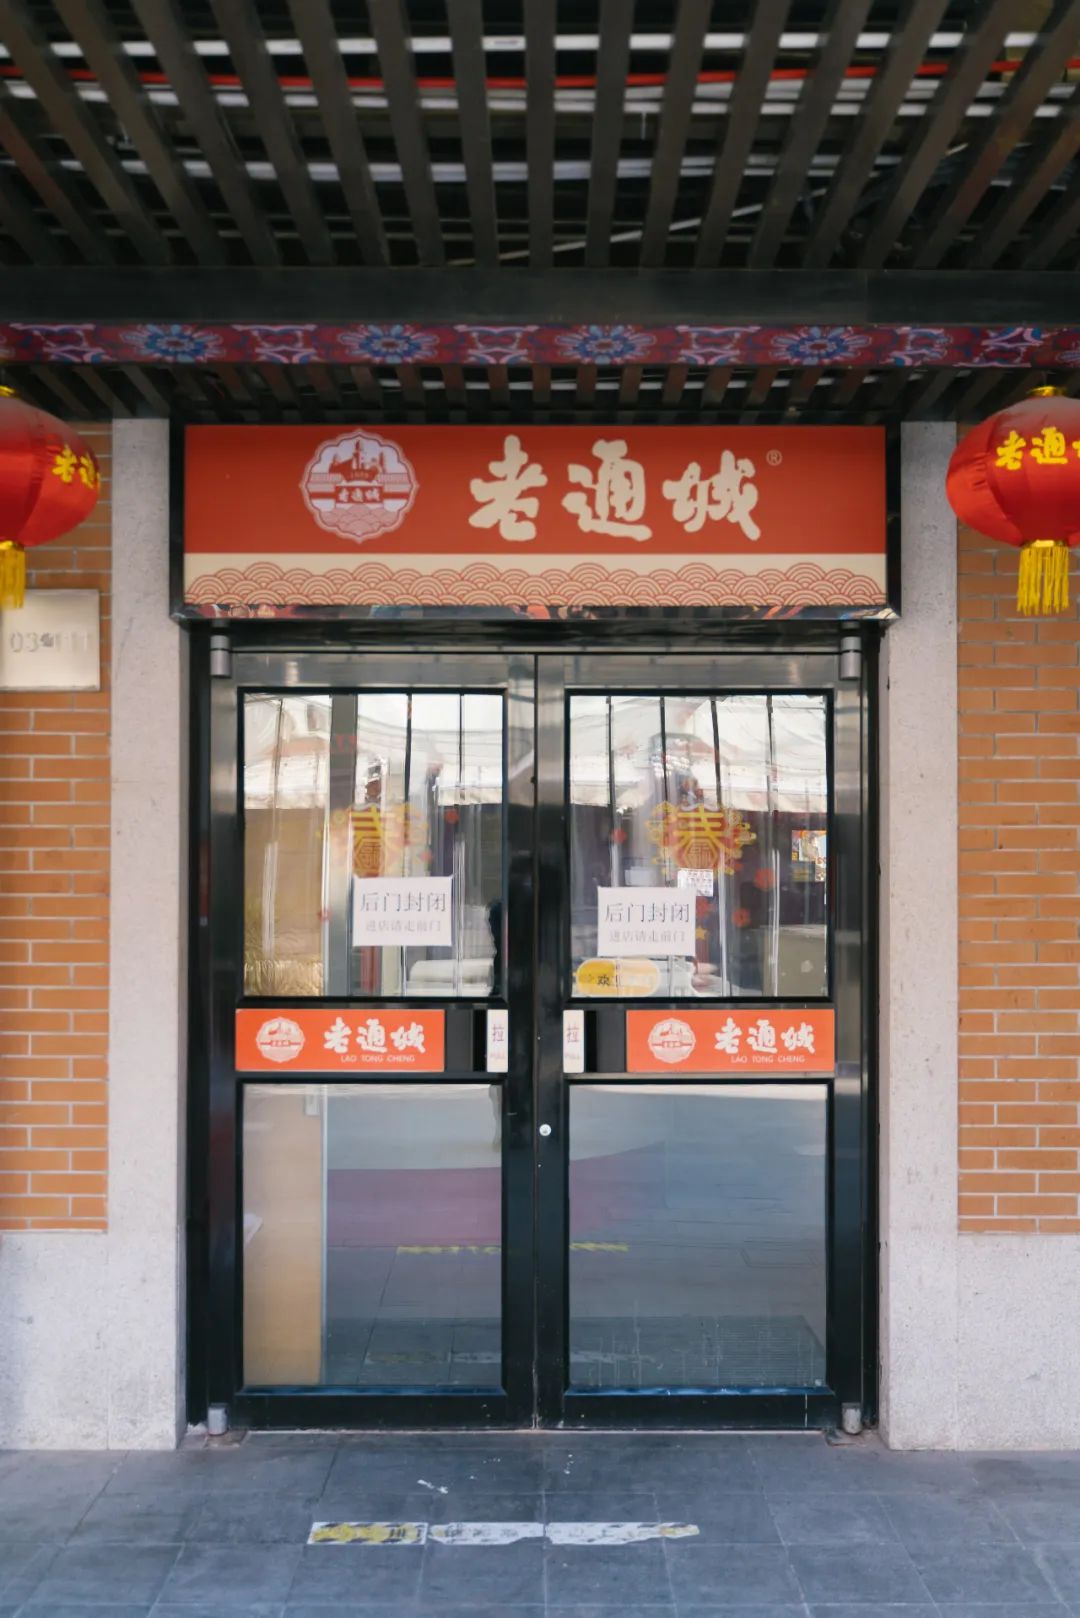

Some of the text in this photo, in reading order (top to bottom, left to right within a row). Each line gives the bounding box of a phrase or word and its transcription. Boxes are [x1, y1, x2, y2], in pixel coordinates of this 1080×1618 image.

[468, 434, 761, 541] 老通城
[360, 891, 446, 912] 后门封闭
[604, 902, 689, 923] 后门封闭
[323, 1016, 426, 1054] 老通城
[714, 1017, 815, 1054] 老通城
[340, 1054, 357, 1063] LAO
[361, 1054, 383, 1063] TONG
[731, 1055, 806, 1064] LAO TONG CHENG
